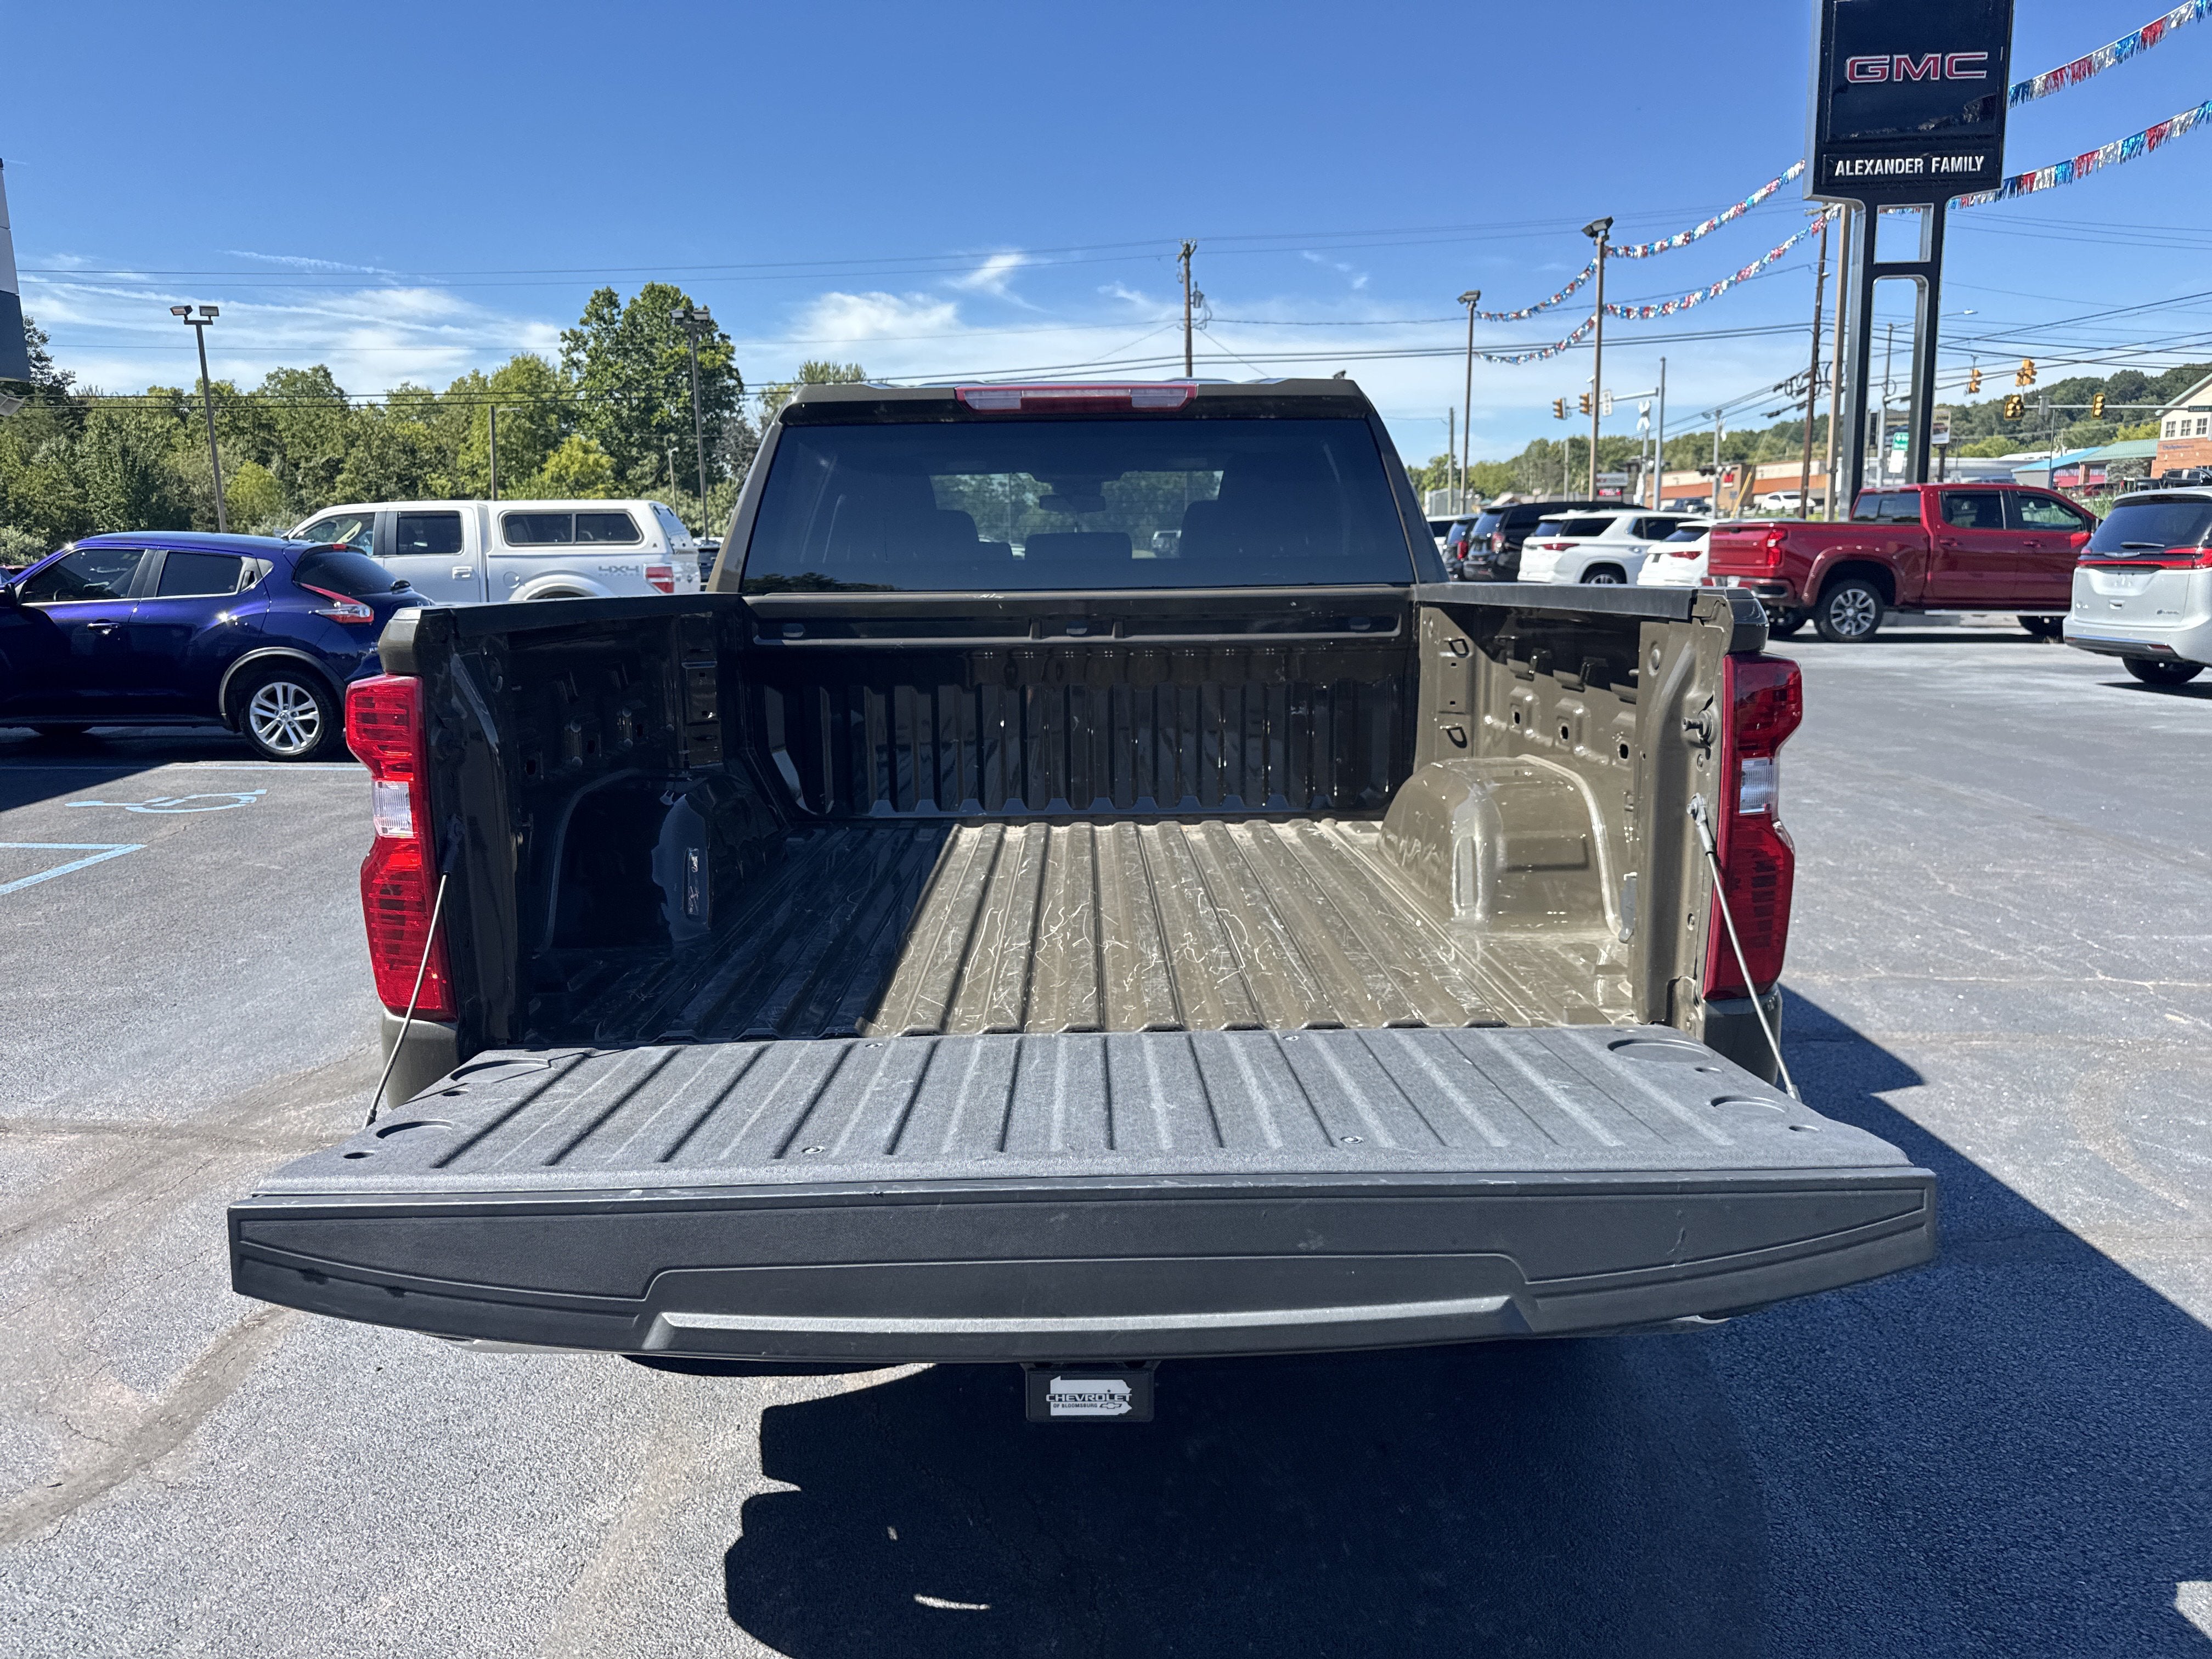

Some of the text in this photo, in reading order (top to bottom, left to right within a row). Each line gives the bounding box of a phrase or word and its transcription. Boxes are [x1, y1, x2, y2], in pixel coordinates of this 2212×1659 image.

[1847, 52, 1988, 83] GMC
[1835, 155, 1985, 177] ALEXANDER FAMILY
[1046, 1393, 1132, 1402] CHEVROLET
